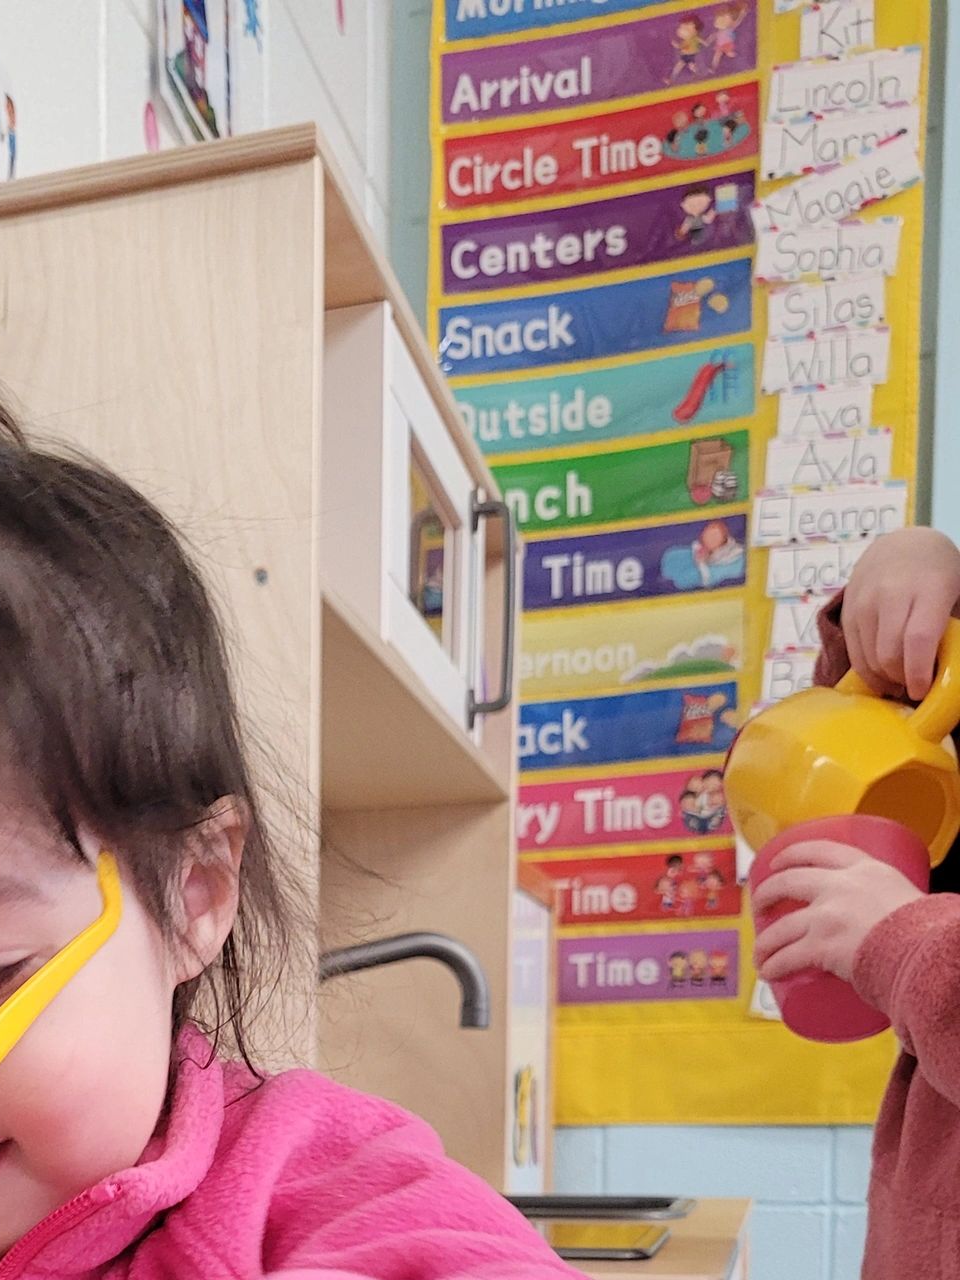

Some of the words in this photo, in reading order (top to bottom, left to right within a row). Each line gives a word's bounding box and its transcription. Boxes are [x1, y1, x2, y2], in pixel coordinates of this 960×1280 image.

[818, 5, 874, 53] Kit
[449, 56, 591, 114] Arrival
[778, 60, 902, 113] Lincoln
[448, 147, 558, 197] Circle
[572, 134, 663, 179] Time
[450, 225, 628, 280] Centers
[773, 228, 884, 276] Sophia
[445, 304, 576, 361] Snack
[782, 284, 875, 332] Silas
[784, 333, 872, 386] Willa
[792, 394, 862, 435] Ava
[503, 470, 594, 524] nch
[759, 497, 898, 538] Eleanor
[541, 551, 645, 600] Time
[519, 642, 638, 680] ernoon
[518, 708, 590, 758] ack
[573, 785, 673, 835] Time
[568, 951, 661, 989] Time
